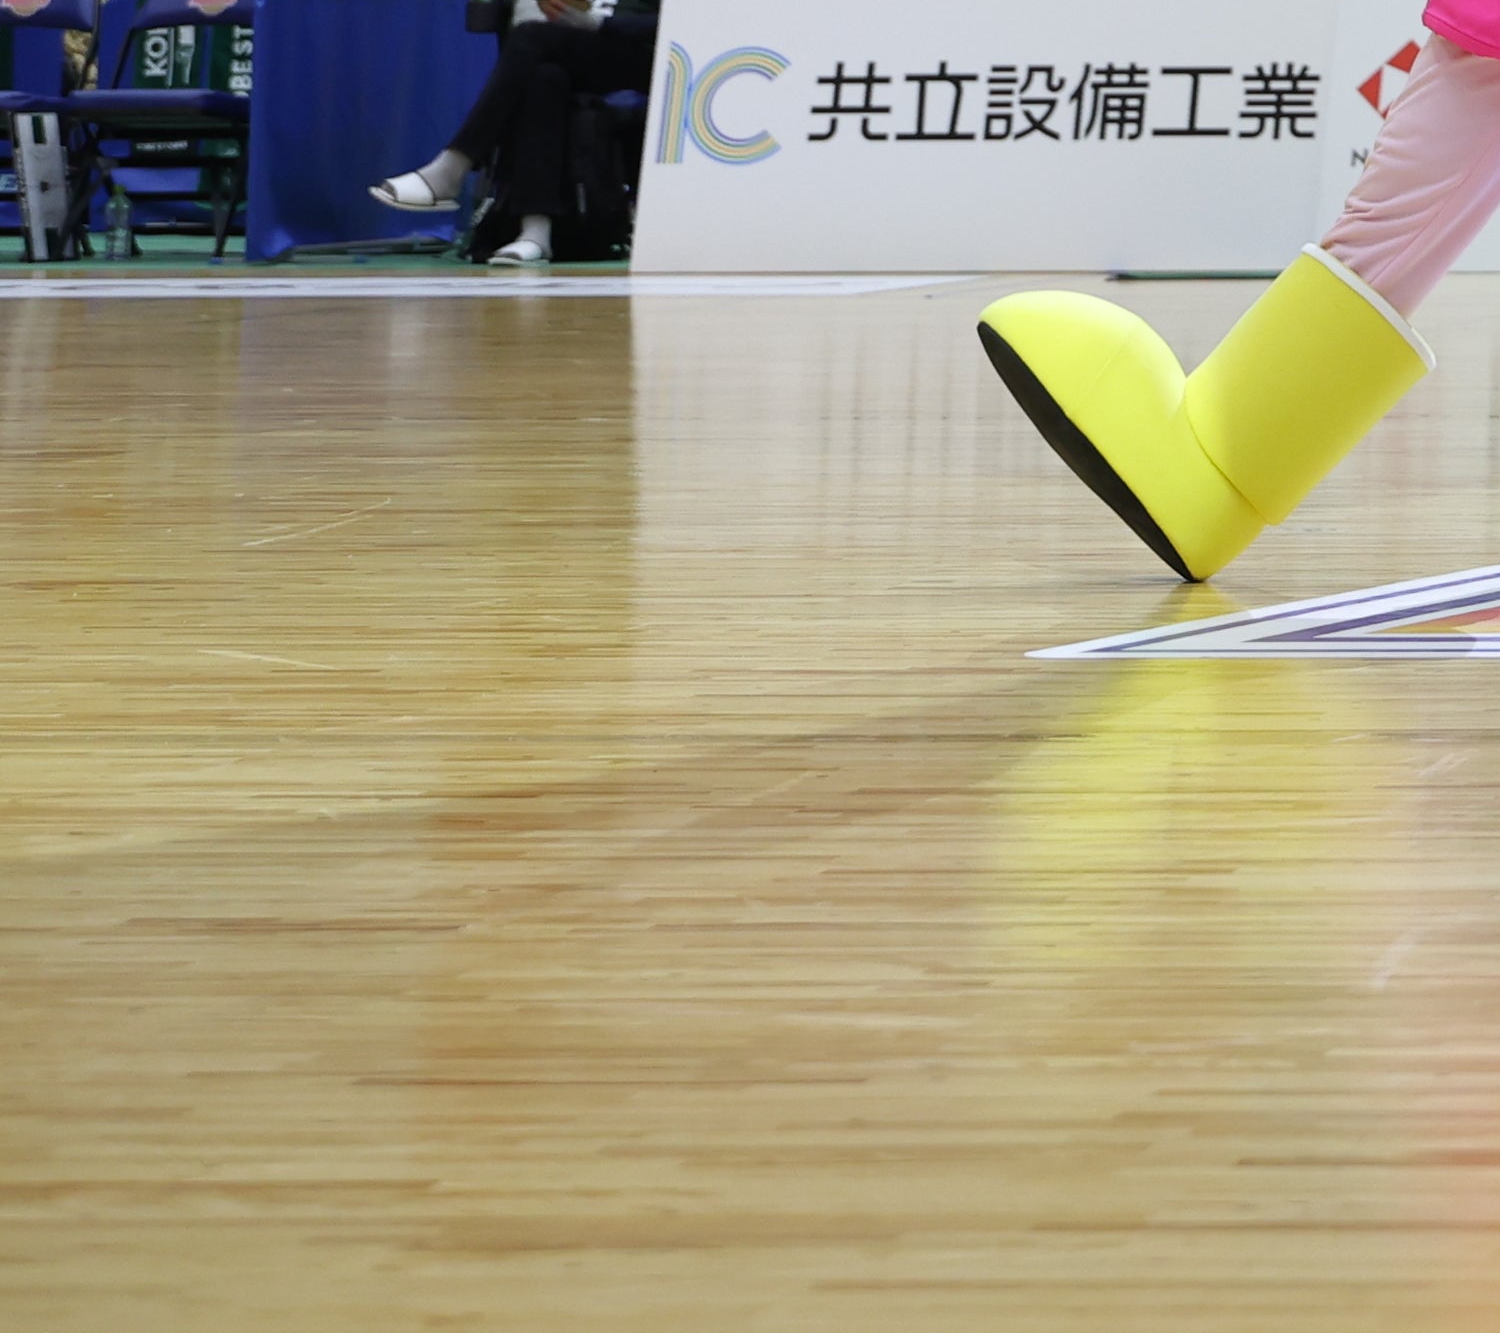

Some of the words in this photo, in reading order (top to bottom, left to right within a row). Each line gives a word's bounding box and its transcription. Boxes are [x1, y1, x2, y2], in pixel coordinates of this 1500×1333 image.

[806, 59, 1322, 142] 共立設備工業
